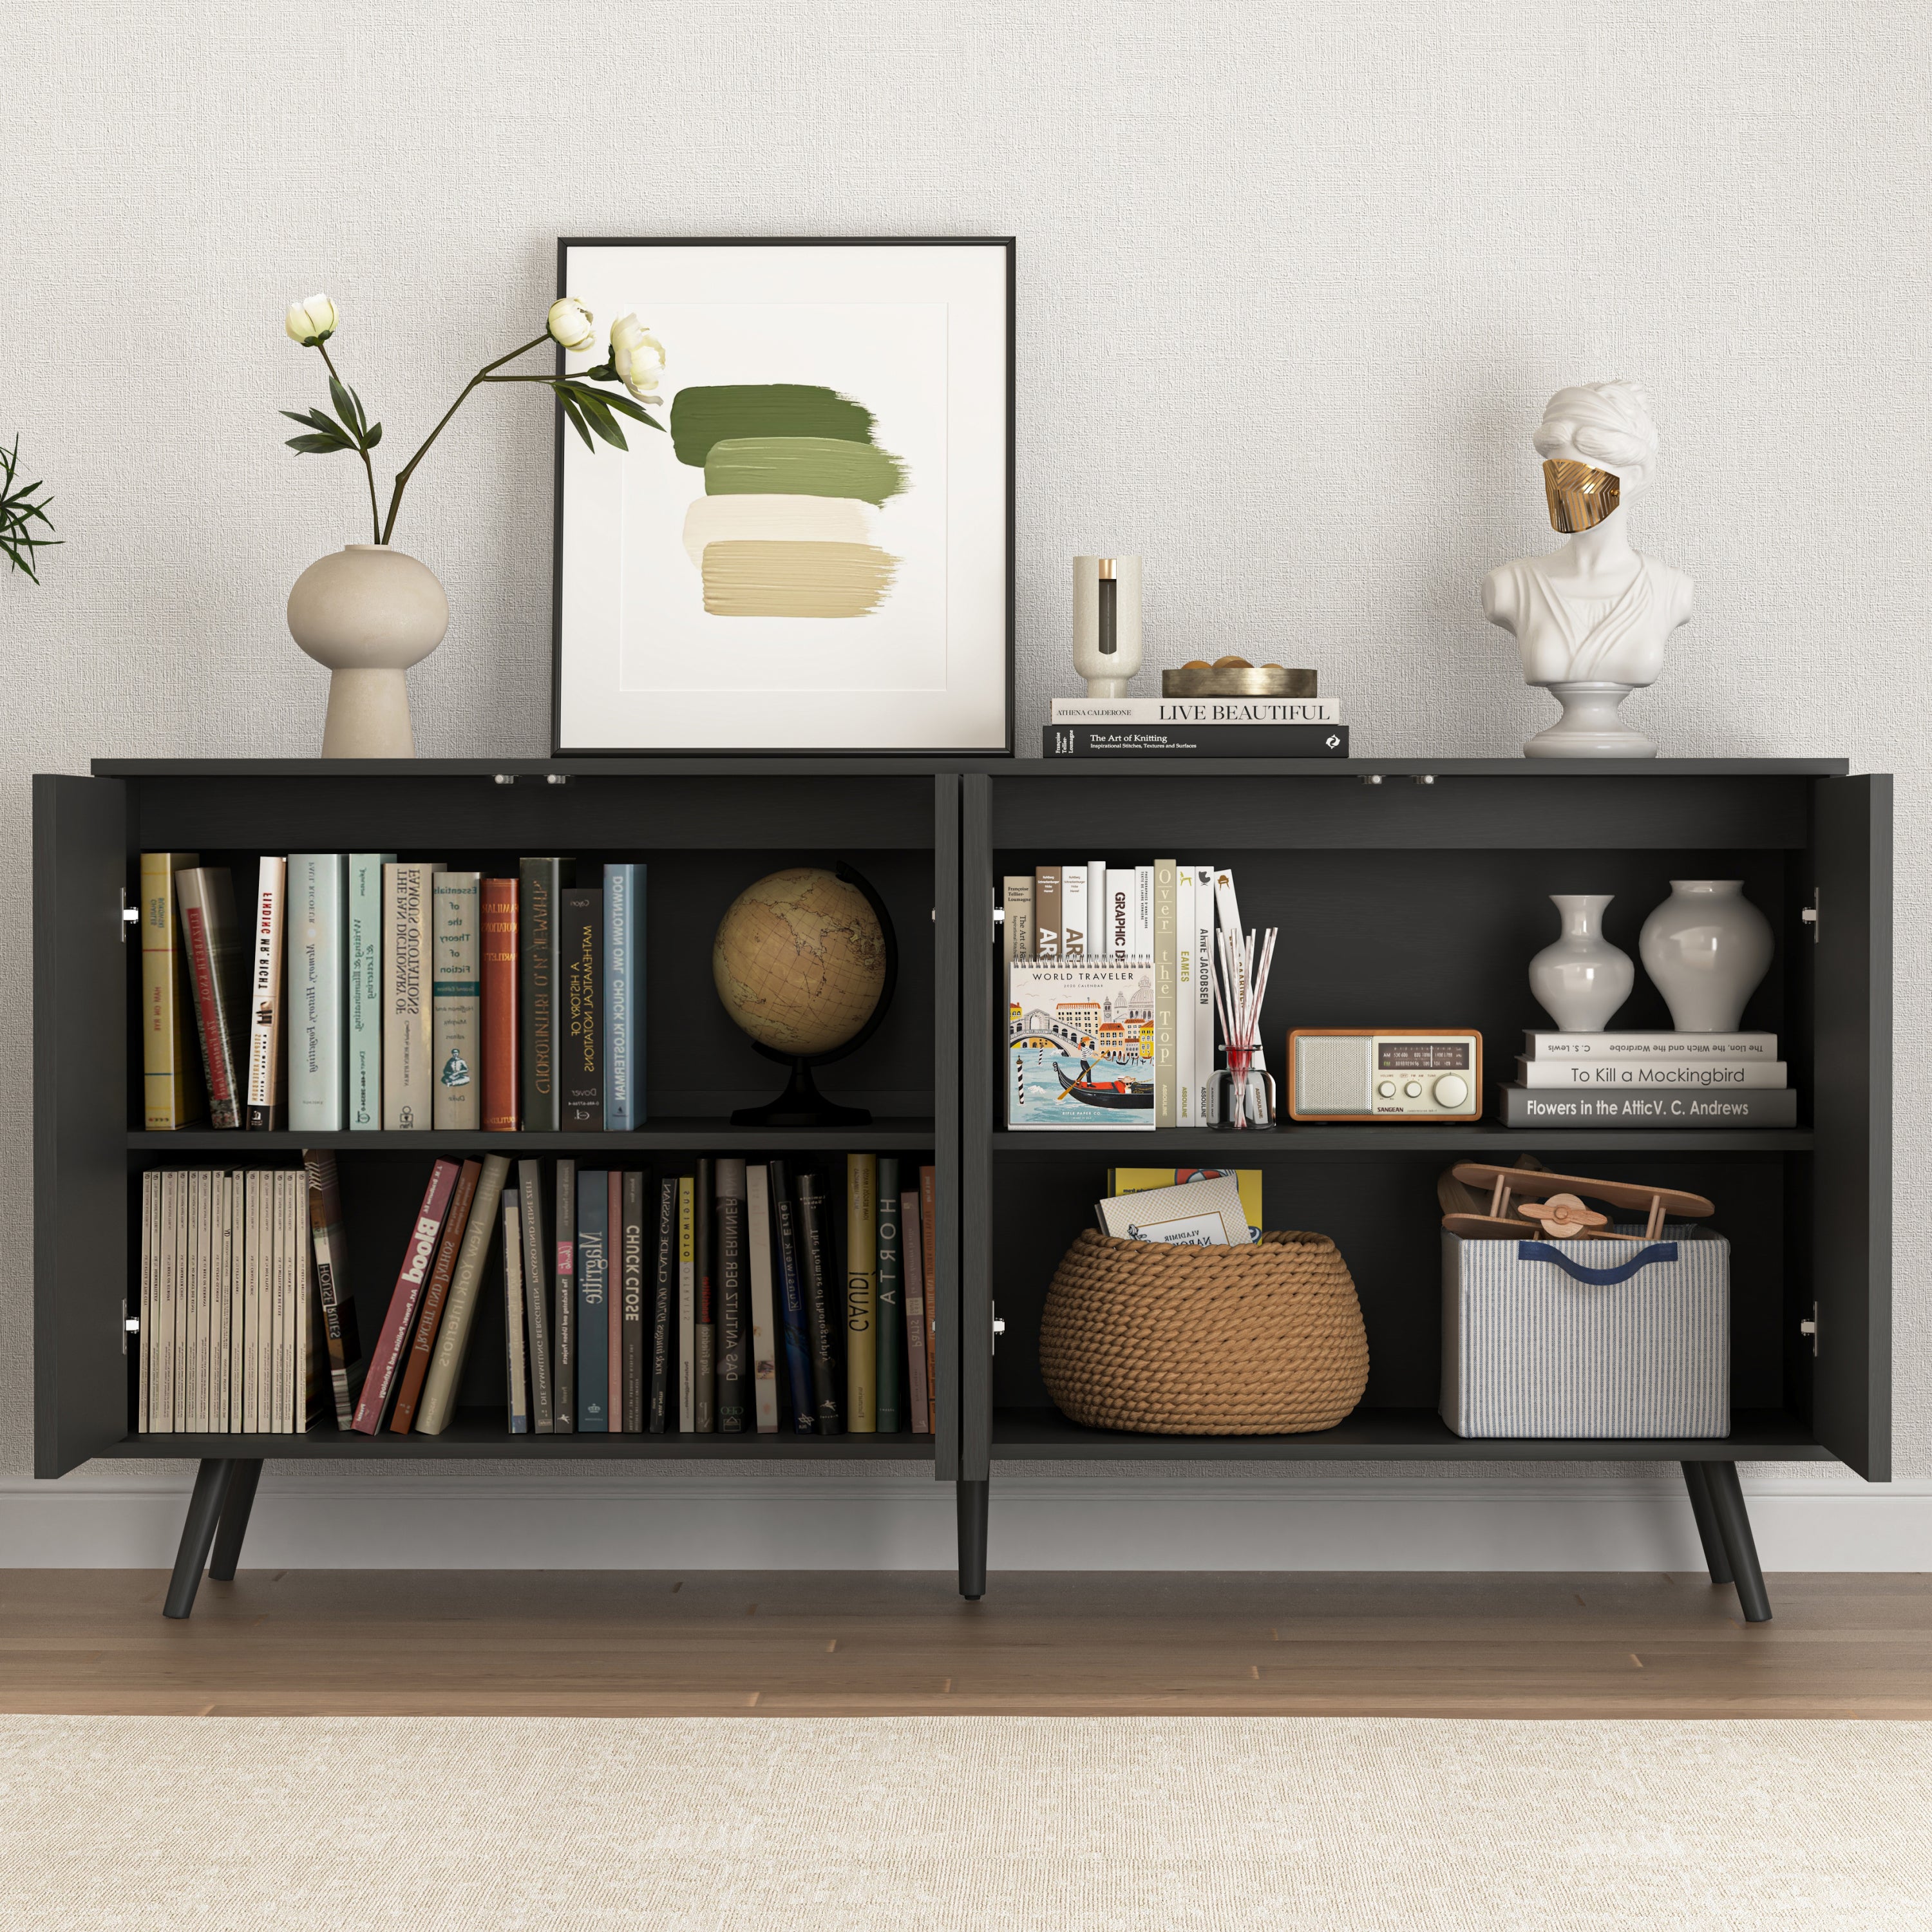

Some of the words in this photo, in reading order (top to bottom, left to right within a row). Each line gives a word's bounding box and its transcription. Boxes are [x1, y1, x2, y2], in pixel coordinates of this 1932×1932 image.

[1159, 705, 1206, 720] LIVE
[1212, 705, 1330, 720] BEAUTIFUL
[1133, 734, 1168, 744] Knitting
[1159, 869, 1171, 931] Over
[1115, 892, 1126, 946] GRAPHIC
[1161, 950, 1170, 994] the
[1181, 951, 1189, 983] EAMES
[1200, 956, 1209, 1005] JACOBSEN
[1159, 1011, 1171, 1063] Top
[1571, 1068, 1590, 1082] To
[1596, 1068, 1616, 1082] Kill
[1622, 1071, 1633, 1082] a
[1638, 1068, 1745, 1086] Mockingbird
[1255, 1088, 1264, 1119] ASSOULINE
[1527, 1100, 1577, 1115] Flowers
[1580, 1100, 1592, 1115] in
[1596, 1100, 1618, 1115] the
[1671, 1100, 1685, 1115] C.
[1690, 1100, 1748, 1115] Andrews
